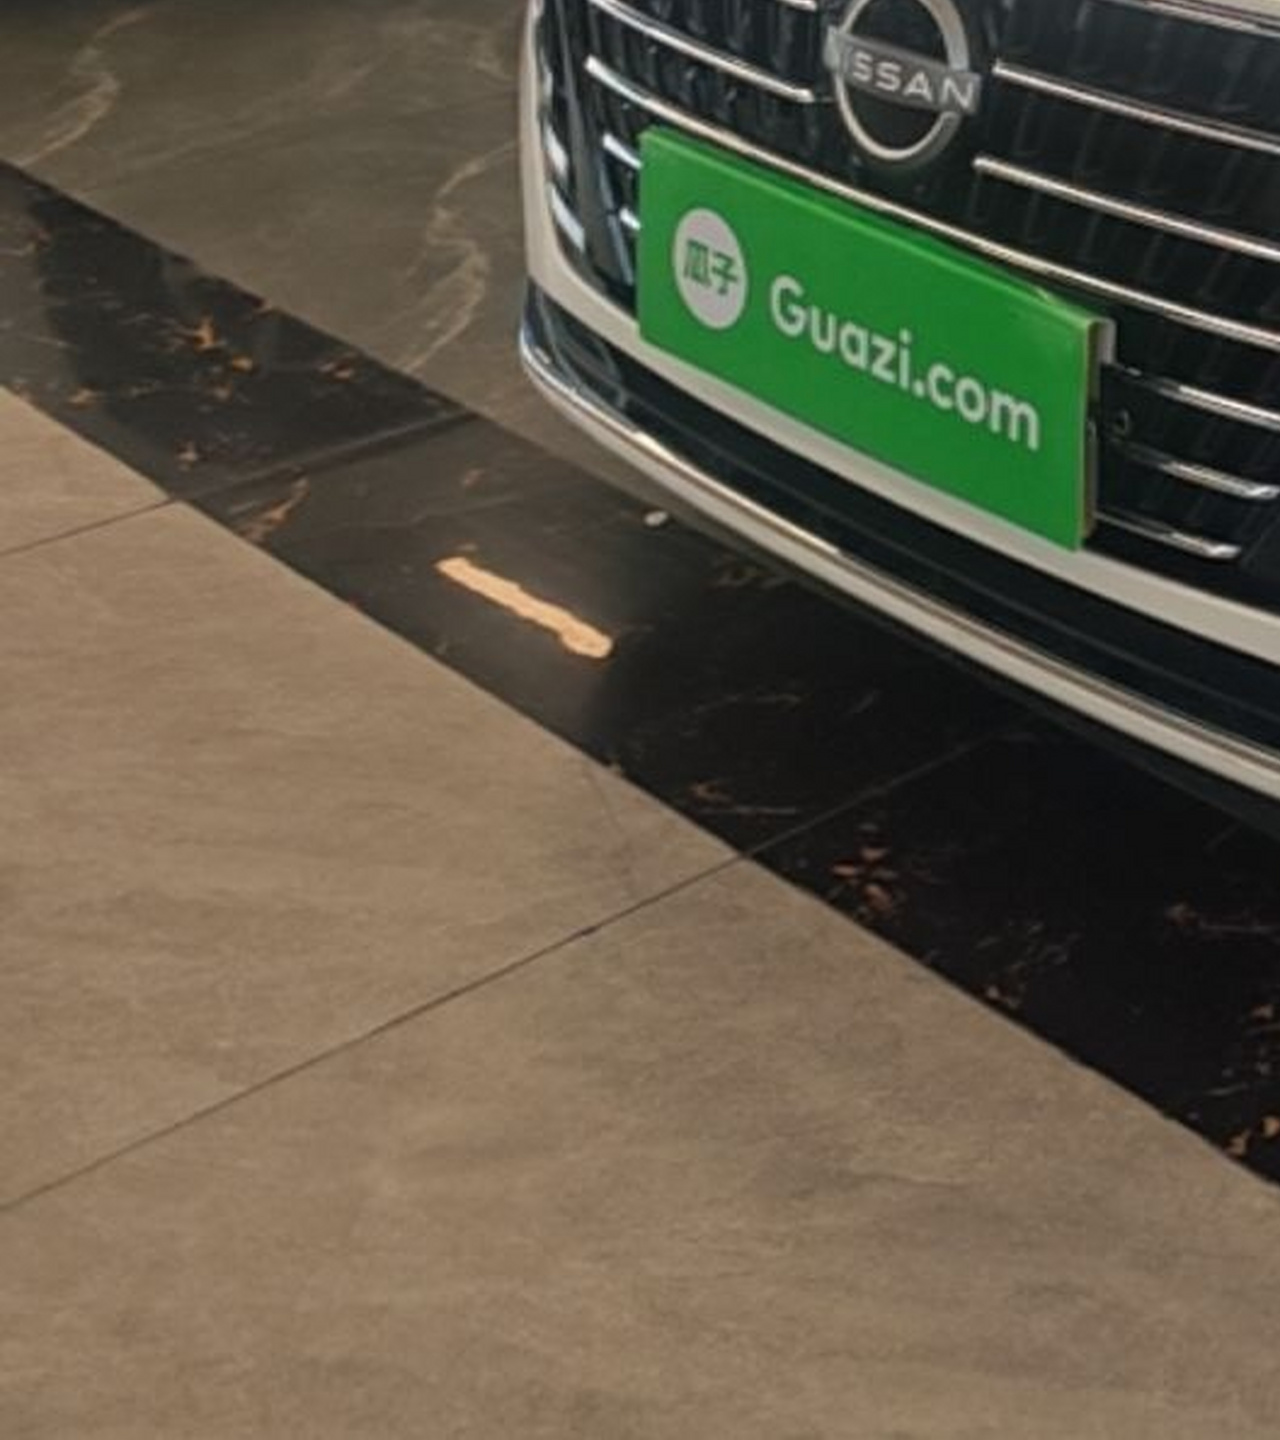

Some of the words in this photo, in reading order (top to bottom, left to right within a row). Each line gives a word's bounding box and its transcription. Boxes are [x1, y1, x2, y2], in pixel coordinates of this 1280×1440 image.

[828, 34, 975, 111] ISSAN
[683, 238, 740, 297] 瓜子
[770, 274, 1040, 452] Guazi.com
